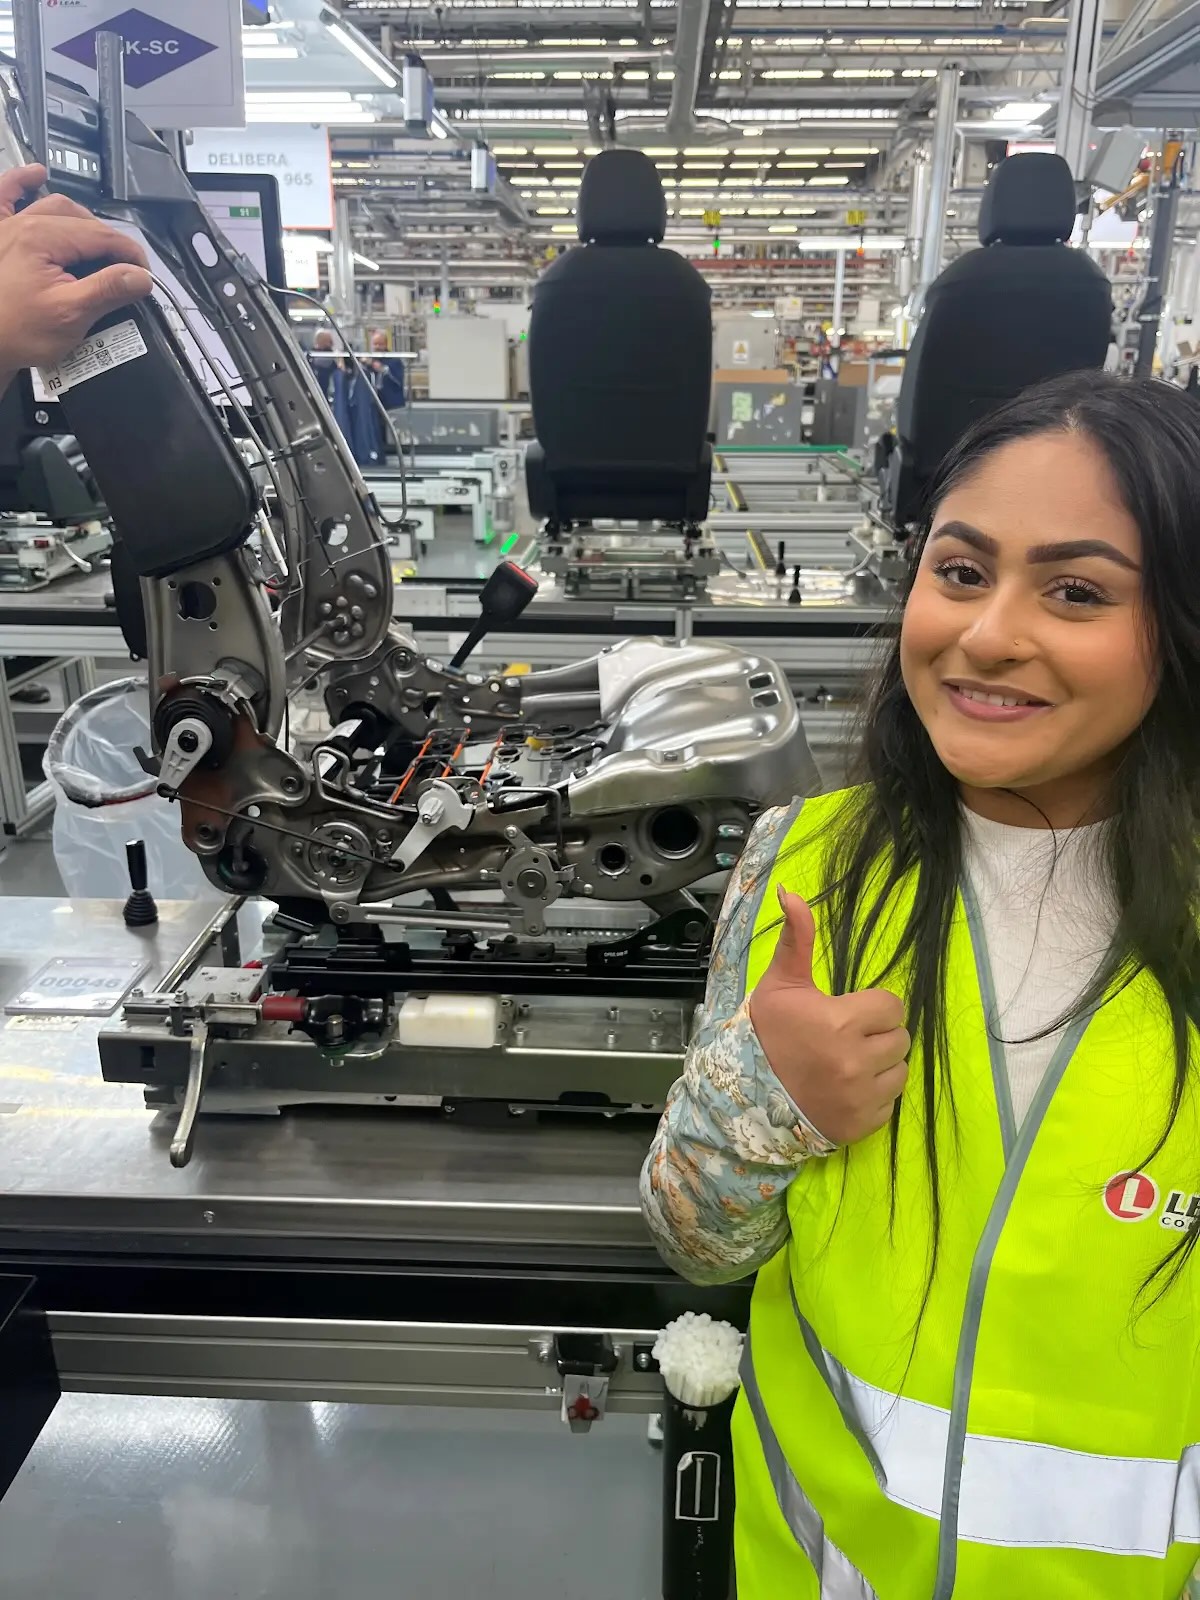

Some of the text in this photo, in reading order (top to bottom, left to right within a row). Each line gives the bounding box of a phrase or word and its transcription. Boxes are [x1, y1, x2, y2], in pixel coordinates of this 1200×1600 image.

[95, 39, 180, 55] K-SC
[208, 153, 288, 167] DELIBERA
[283, 173, 313, 186] 965
[48, 377, 63, 391] EU
[1161, 1216, 1198, 1229] CO
